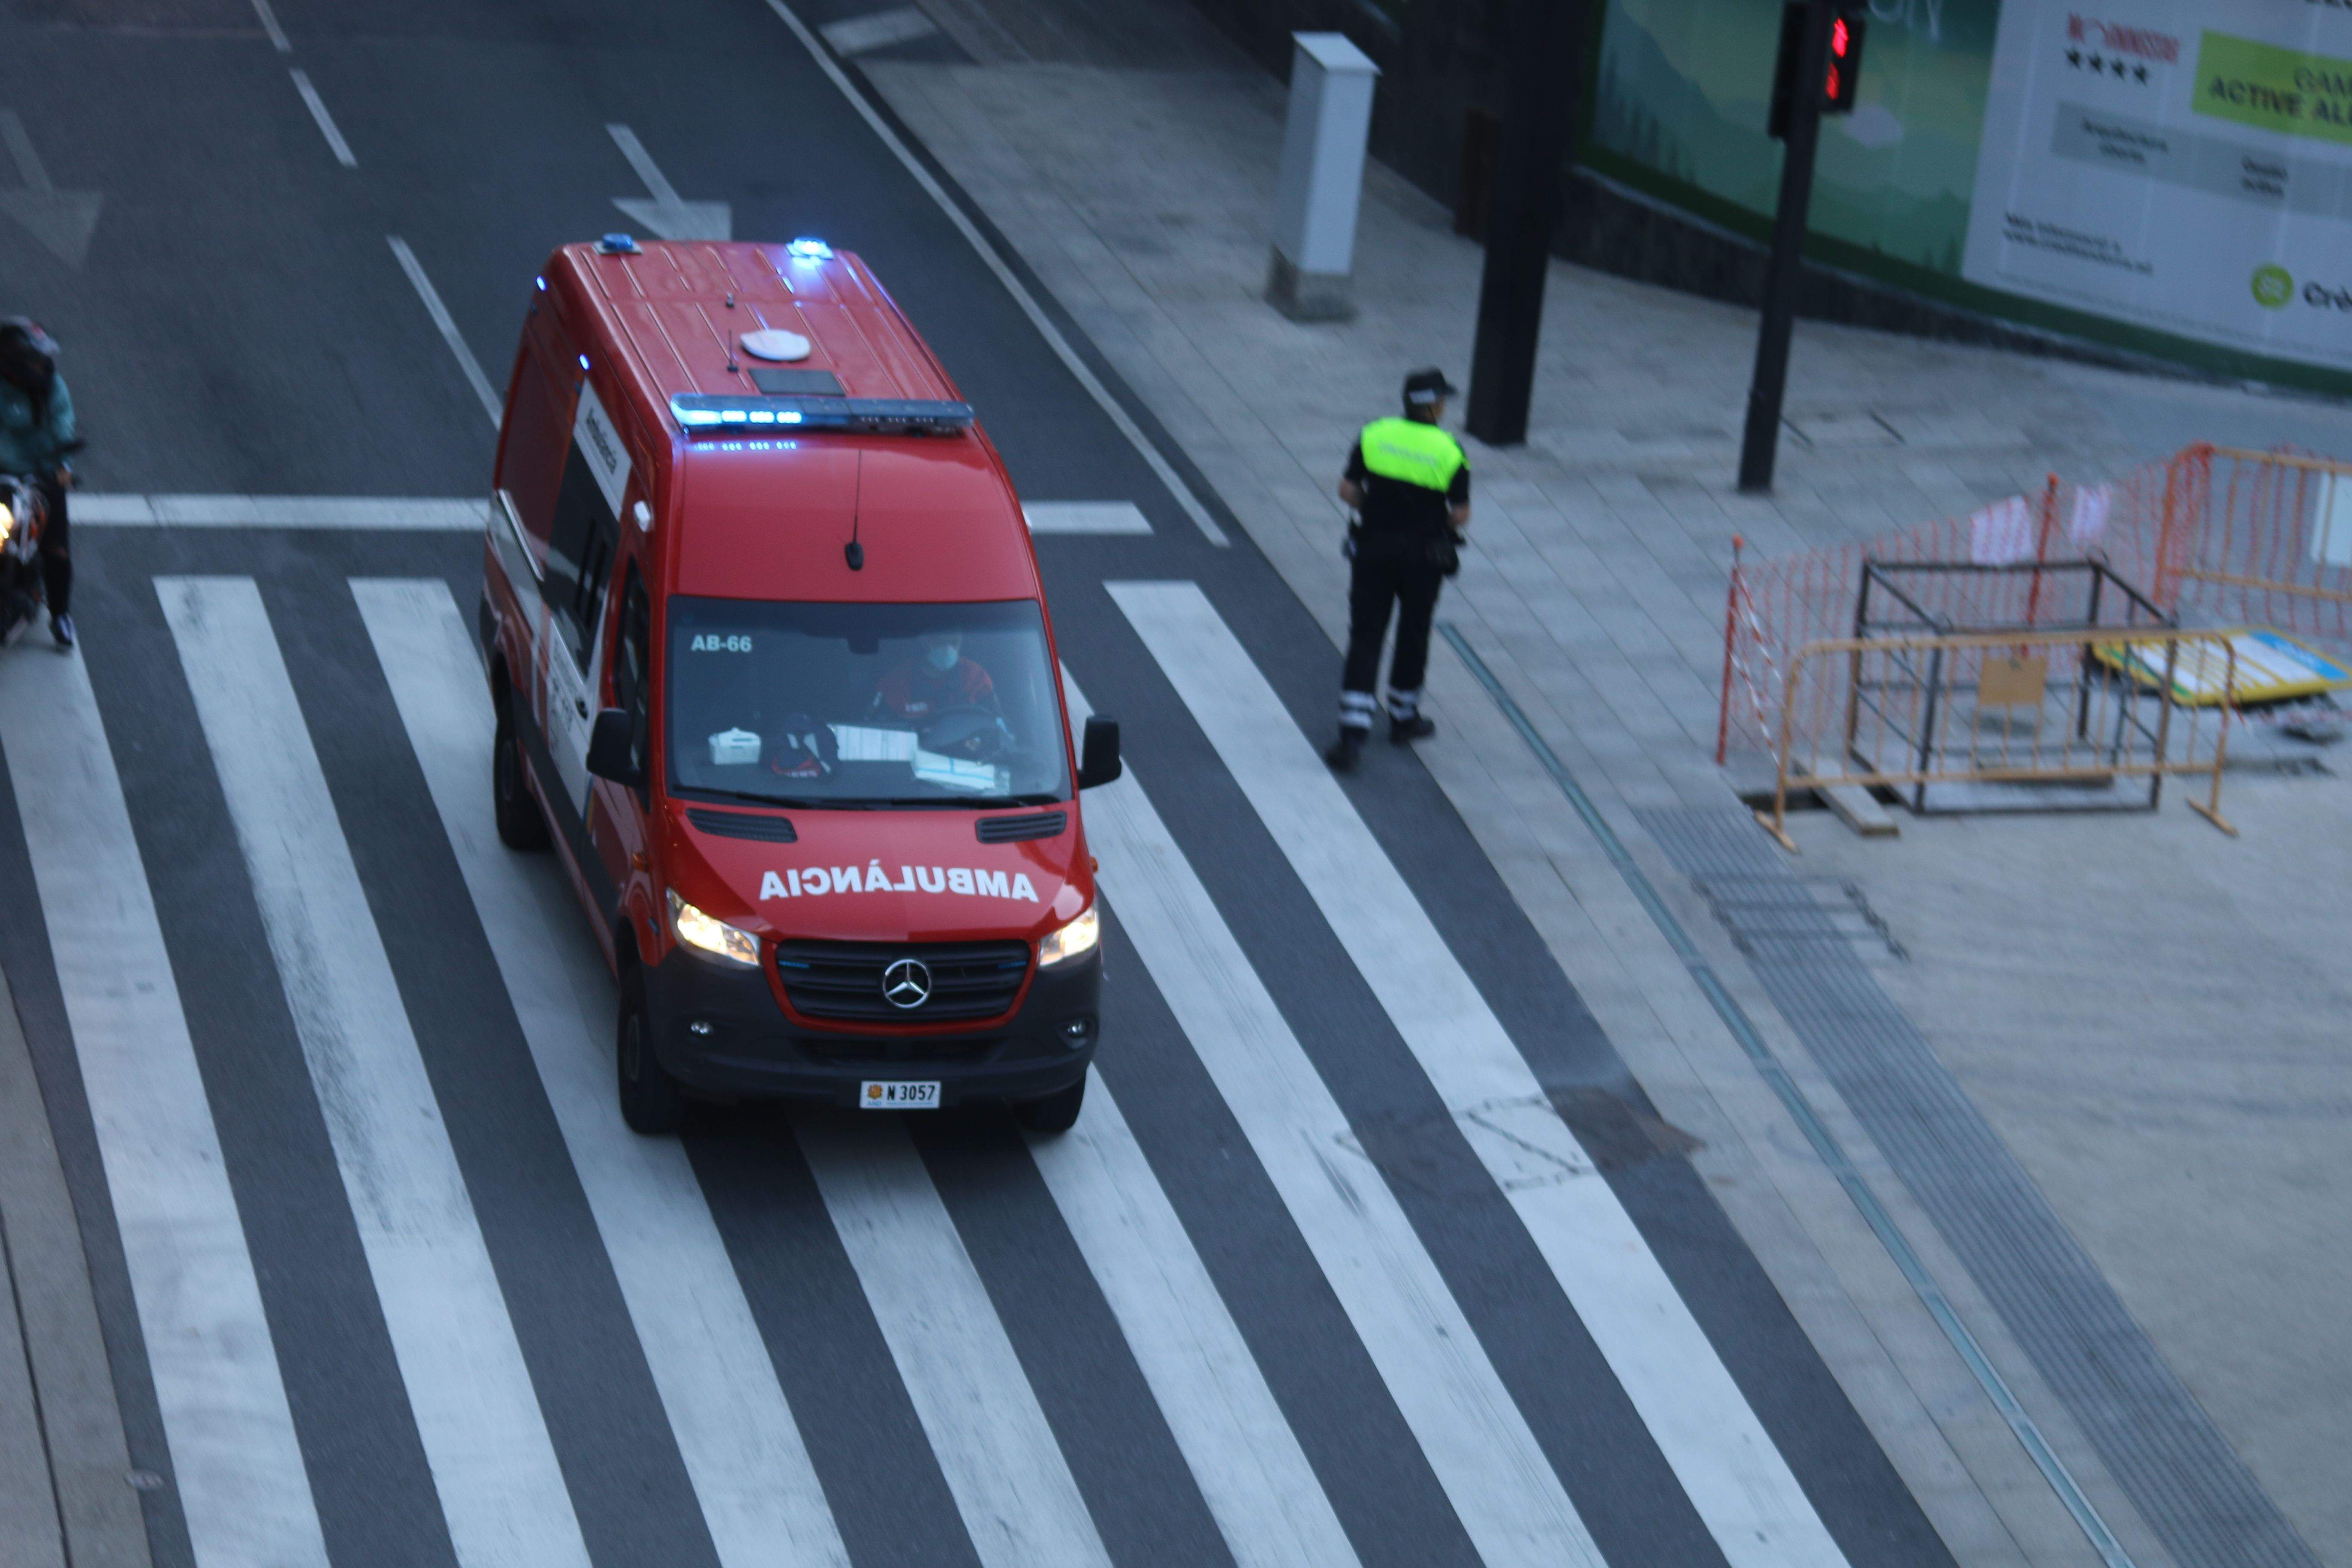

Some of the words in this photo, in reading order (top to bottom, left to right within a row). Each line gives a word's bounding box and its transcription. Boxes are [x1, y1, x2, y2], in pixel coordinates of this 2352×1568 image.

[2210, 75, 2303, 117] ACTIVE
[2312, 97, 2352, 126] AL
[691, 634, 752, 652] AB-66
[887, 1085, 895, 1100] N
[900, 1084, 935, 1100] 3057
